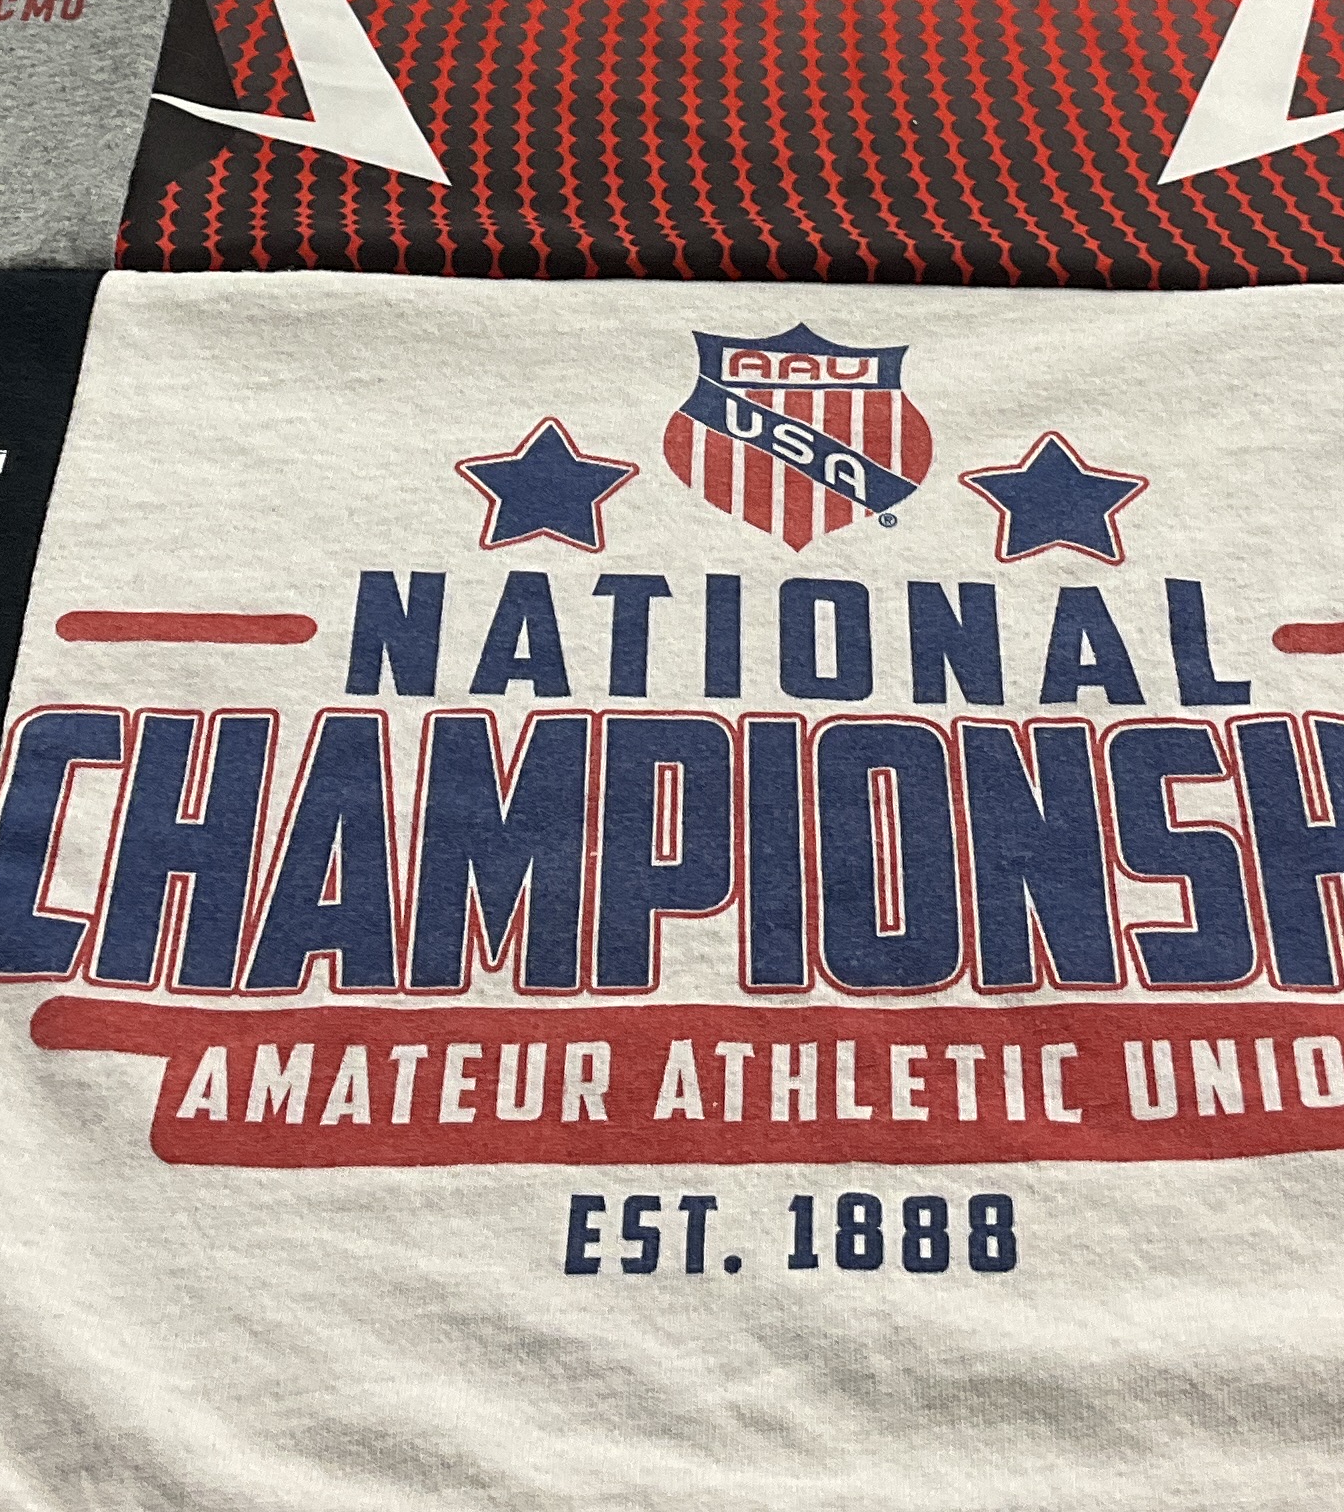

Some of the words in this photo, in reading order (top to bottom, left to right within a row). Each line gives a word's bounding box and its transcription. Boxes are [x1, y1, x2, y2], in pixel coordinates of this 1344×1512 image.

[729, 349, 870, 381] AAU
[725, 397, 867, 502] USA
[346, 568, 1253, 708] NATIONAL
[175, 1036, 610, 1125] AMATEUR
[651, 1036, 1086, 1125] ATHLETIC
[563, 1192, 743, 1277] EST.
[787, 1191, 1019, 1274] 1888
